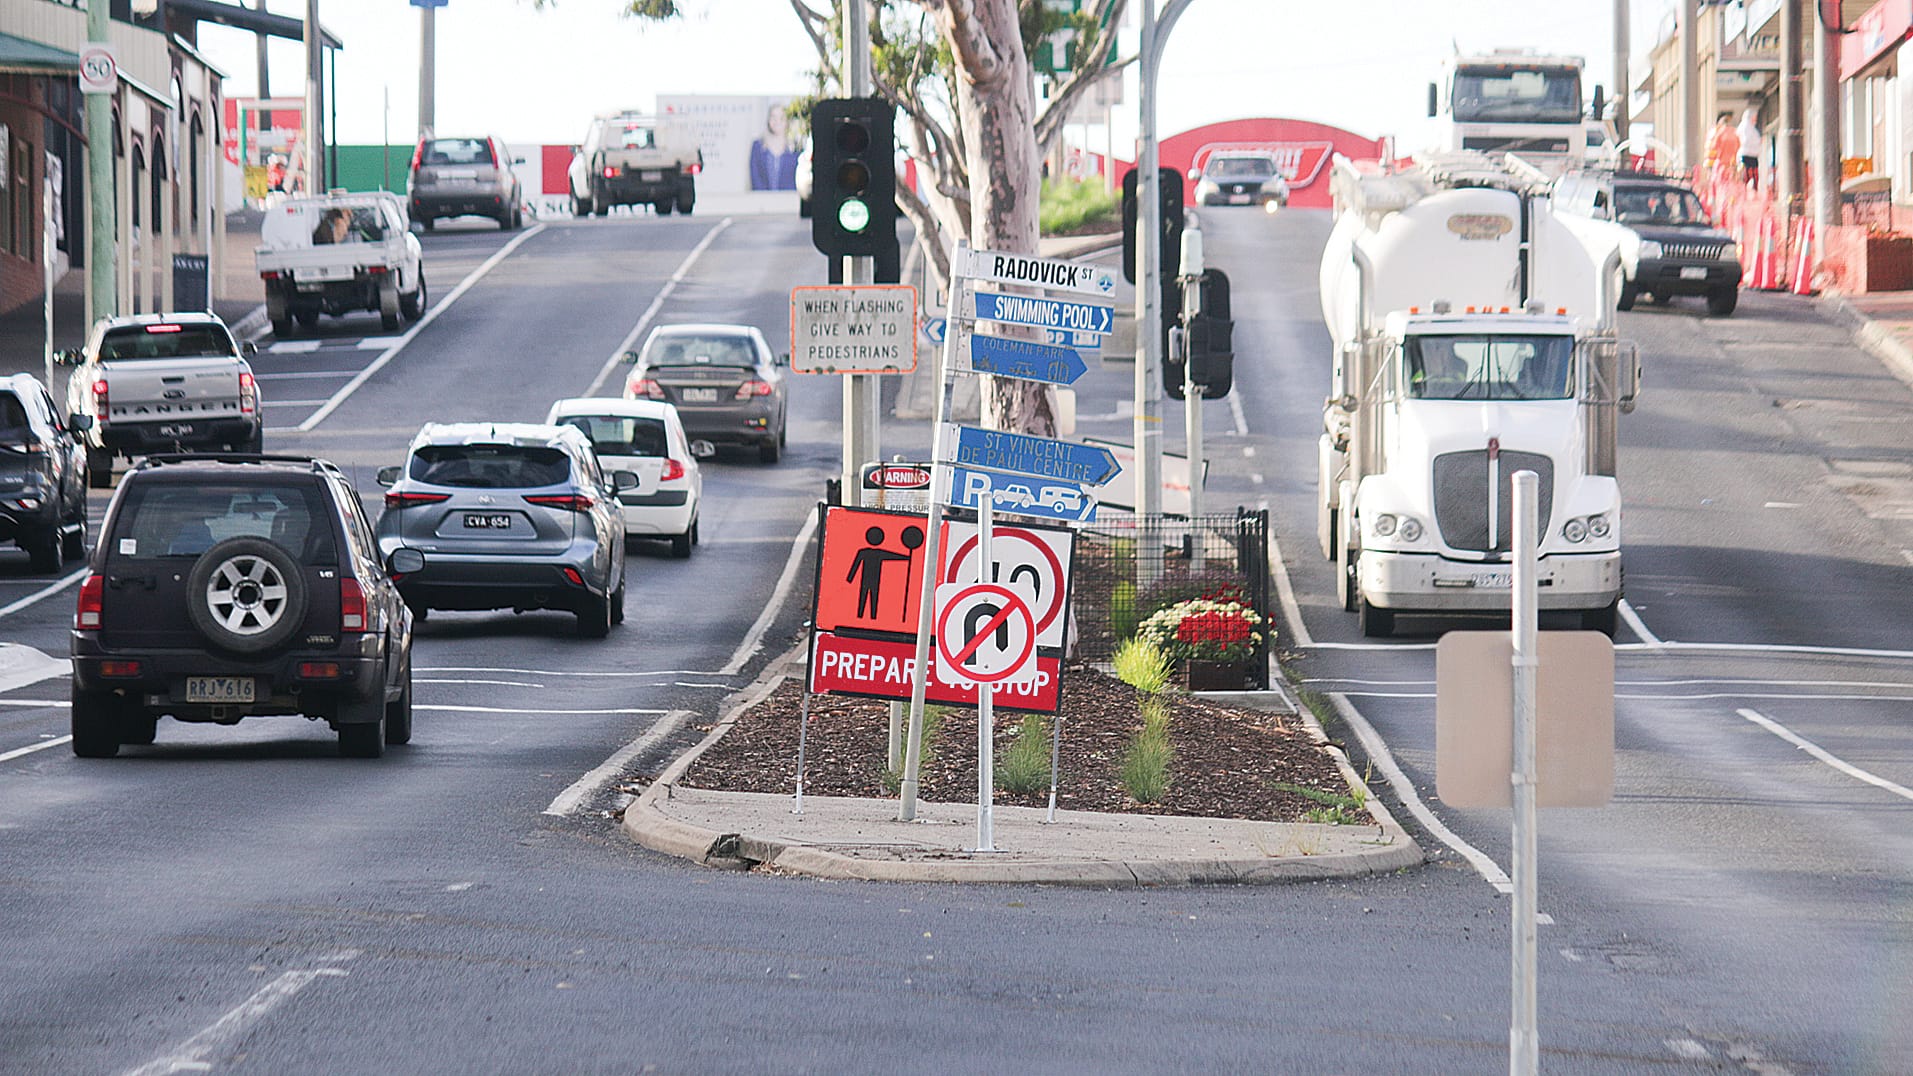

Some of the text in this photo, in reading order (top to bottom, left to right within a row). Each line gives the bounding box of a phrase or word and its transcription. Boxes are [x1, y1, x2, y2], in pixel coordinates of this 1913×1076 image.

[87, 60, 110, 77] 50
[993, 256, 1094, 287] RADOVICK ST
[804, 300, 904, 313] WHEN FLASHING
[994, 296, 1096, 330] SWIMMING POOL
[810, 323, 897, 336] GIVE WAY TO
[809, 345, 899, 359] PEDESTRIANS
[983, 338, 1065, 359] COLEMAN PARK
[112, 401, 237, 416] RANGER
[985, 432, 1074, 461] ST VINCENT
[961, 446, 1093, 482] DE PAUL CENTRE
[875, 471, 926, 484] WARNING
[890, 504, 930, 512] PRESSUR
[821, 650, 933, 688] PREPARE
[190, 679, 252, 696] RRJ 616
